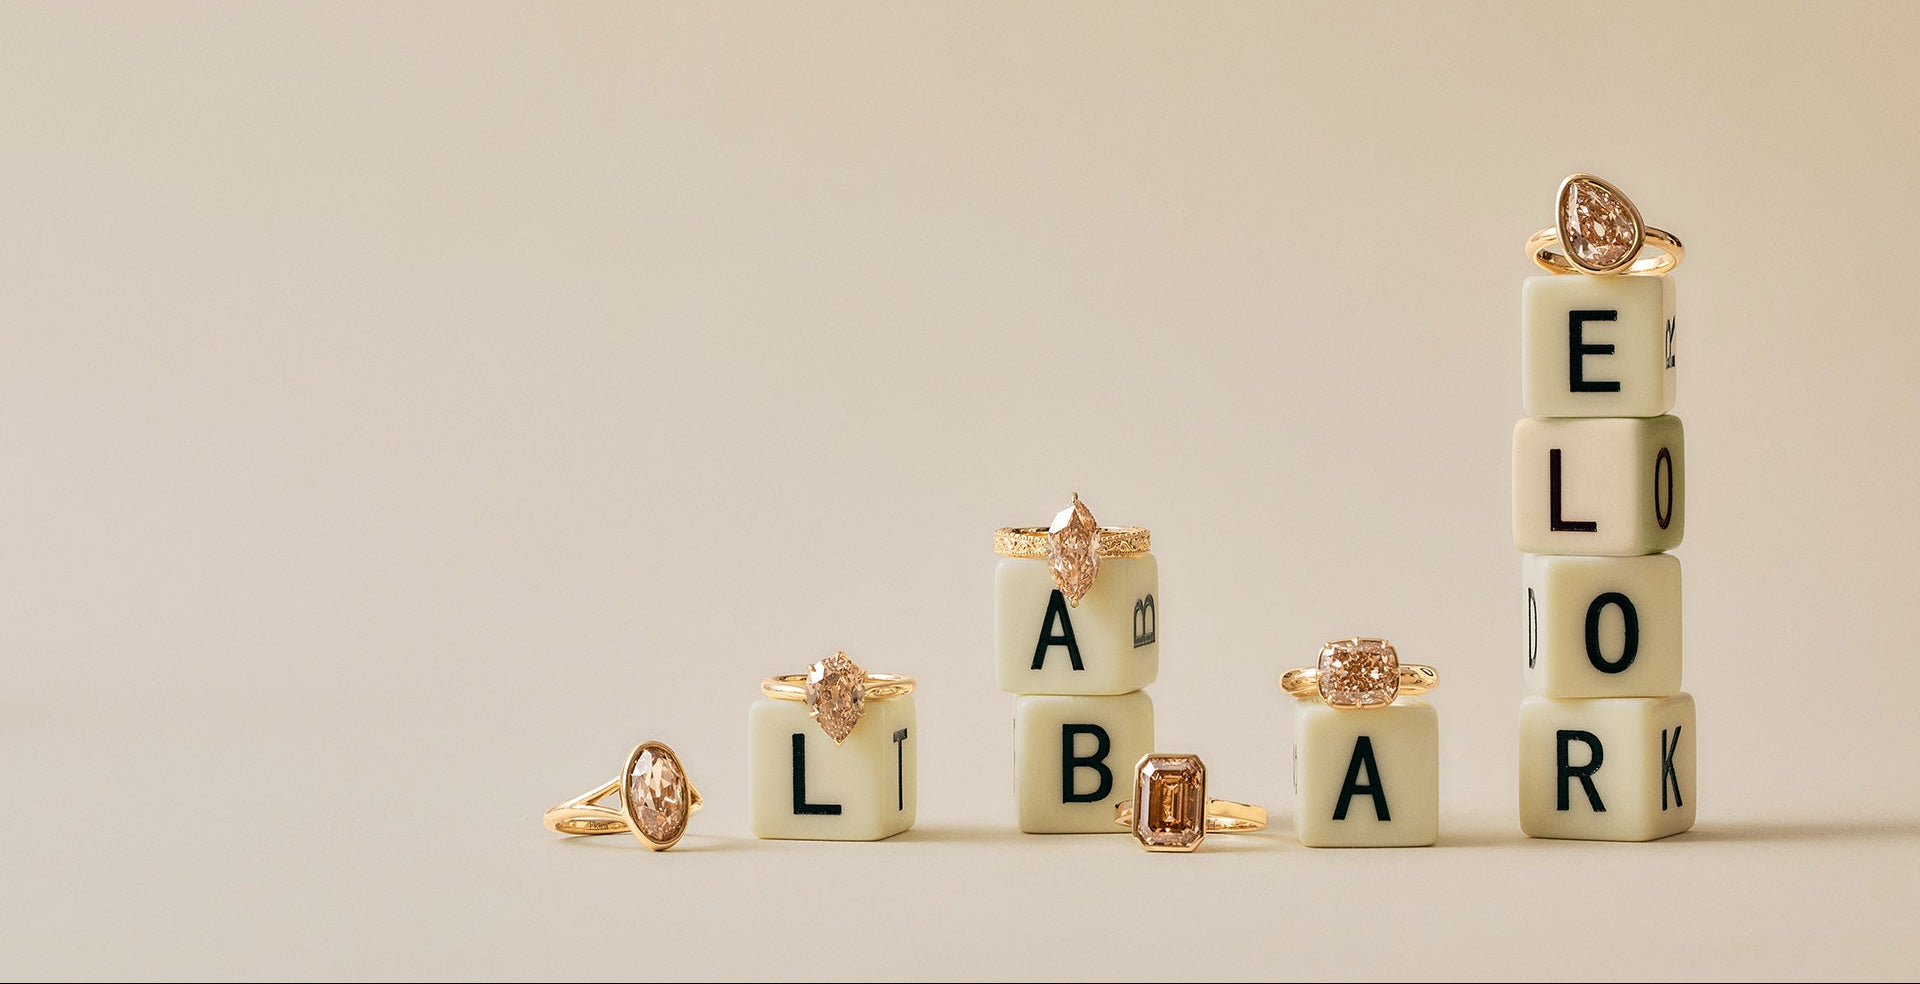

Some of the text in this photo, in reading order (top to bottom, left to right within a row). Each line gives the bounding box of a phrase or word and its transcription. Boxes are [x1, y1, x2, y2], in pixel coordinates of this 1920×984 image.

[1569, 310, 1621, 392] E
[1550, 448, 1597, 532] L
[1031, 589, 1085, 671] A
[1133, 594, 1156, 648] B
[1585, 592, 1639, 674] O
[792, 733, 842, 815] L
[893, 728, 908, 811] T
[1062, 723, 1113, 804] B
[1332, 736, 1392, 821] A
[1556, 730, 1607, 812] R
[1662, 726, 1683, 811] K
